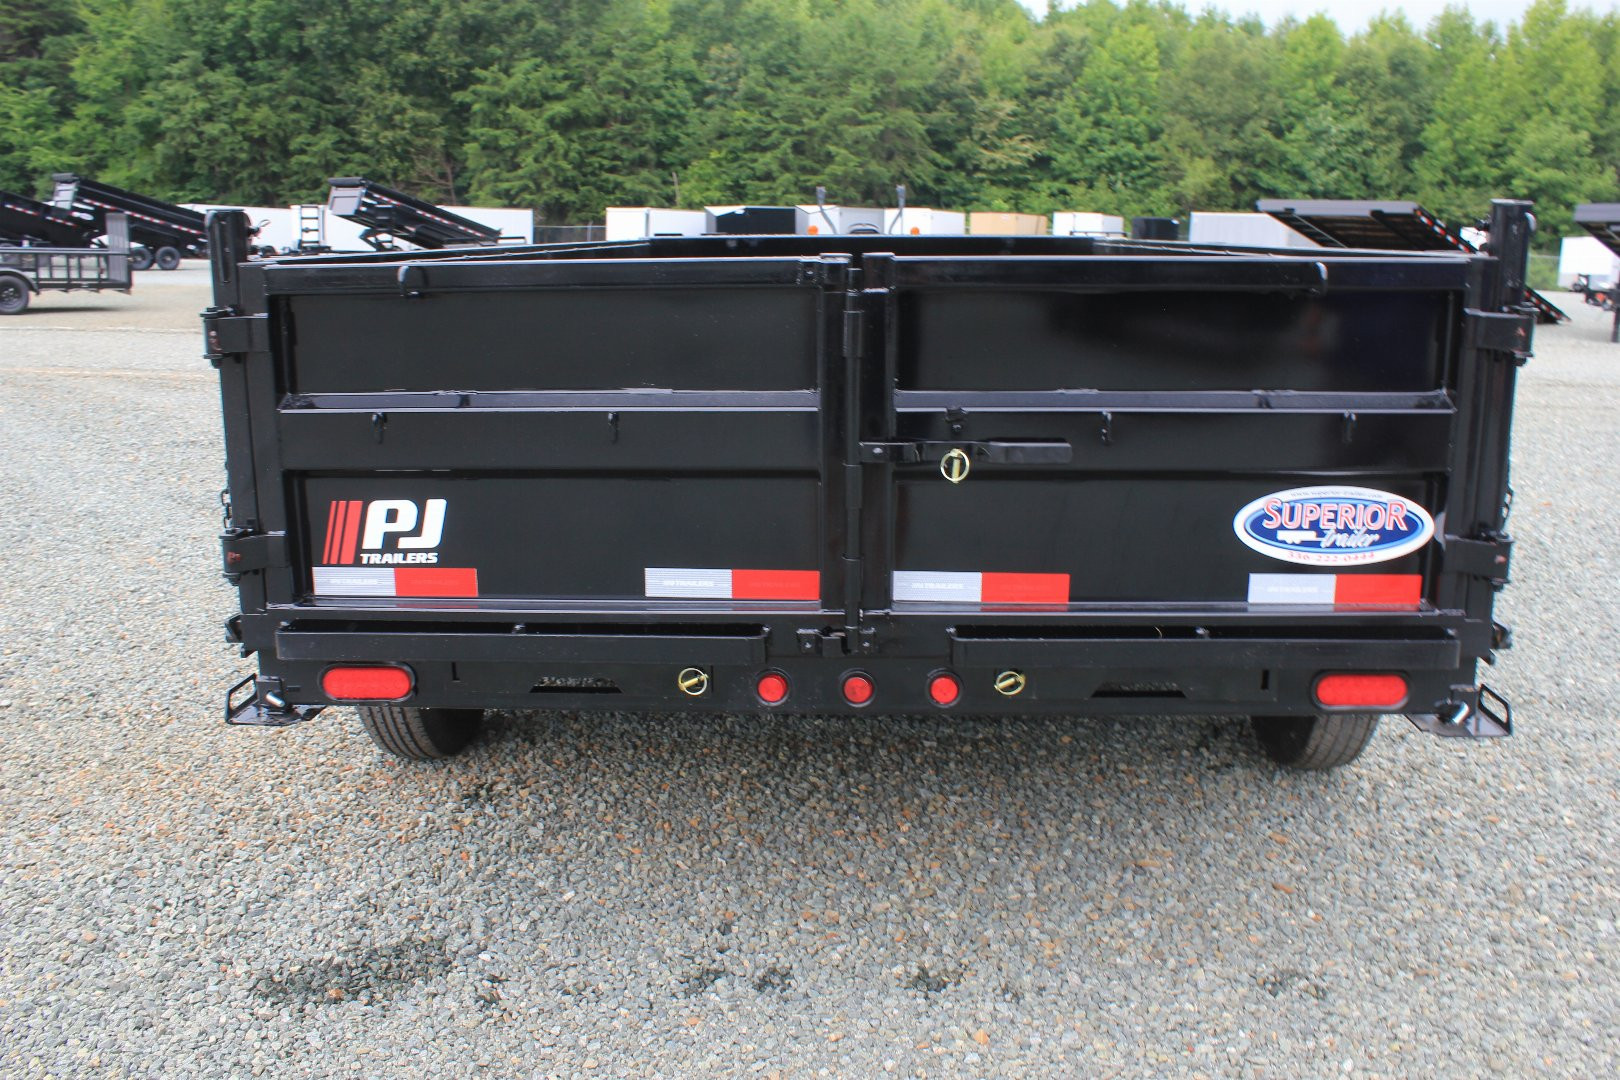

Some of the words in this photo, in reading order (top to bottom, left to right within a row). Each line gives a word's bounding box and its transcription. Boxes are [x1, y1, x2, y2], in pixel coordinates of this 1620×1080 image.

[362, 499, 447, 550] PJ
[1262, 498, 1408, 531] SUPERIOR
[360, 552, 438, 564] TRAILERS
